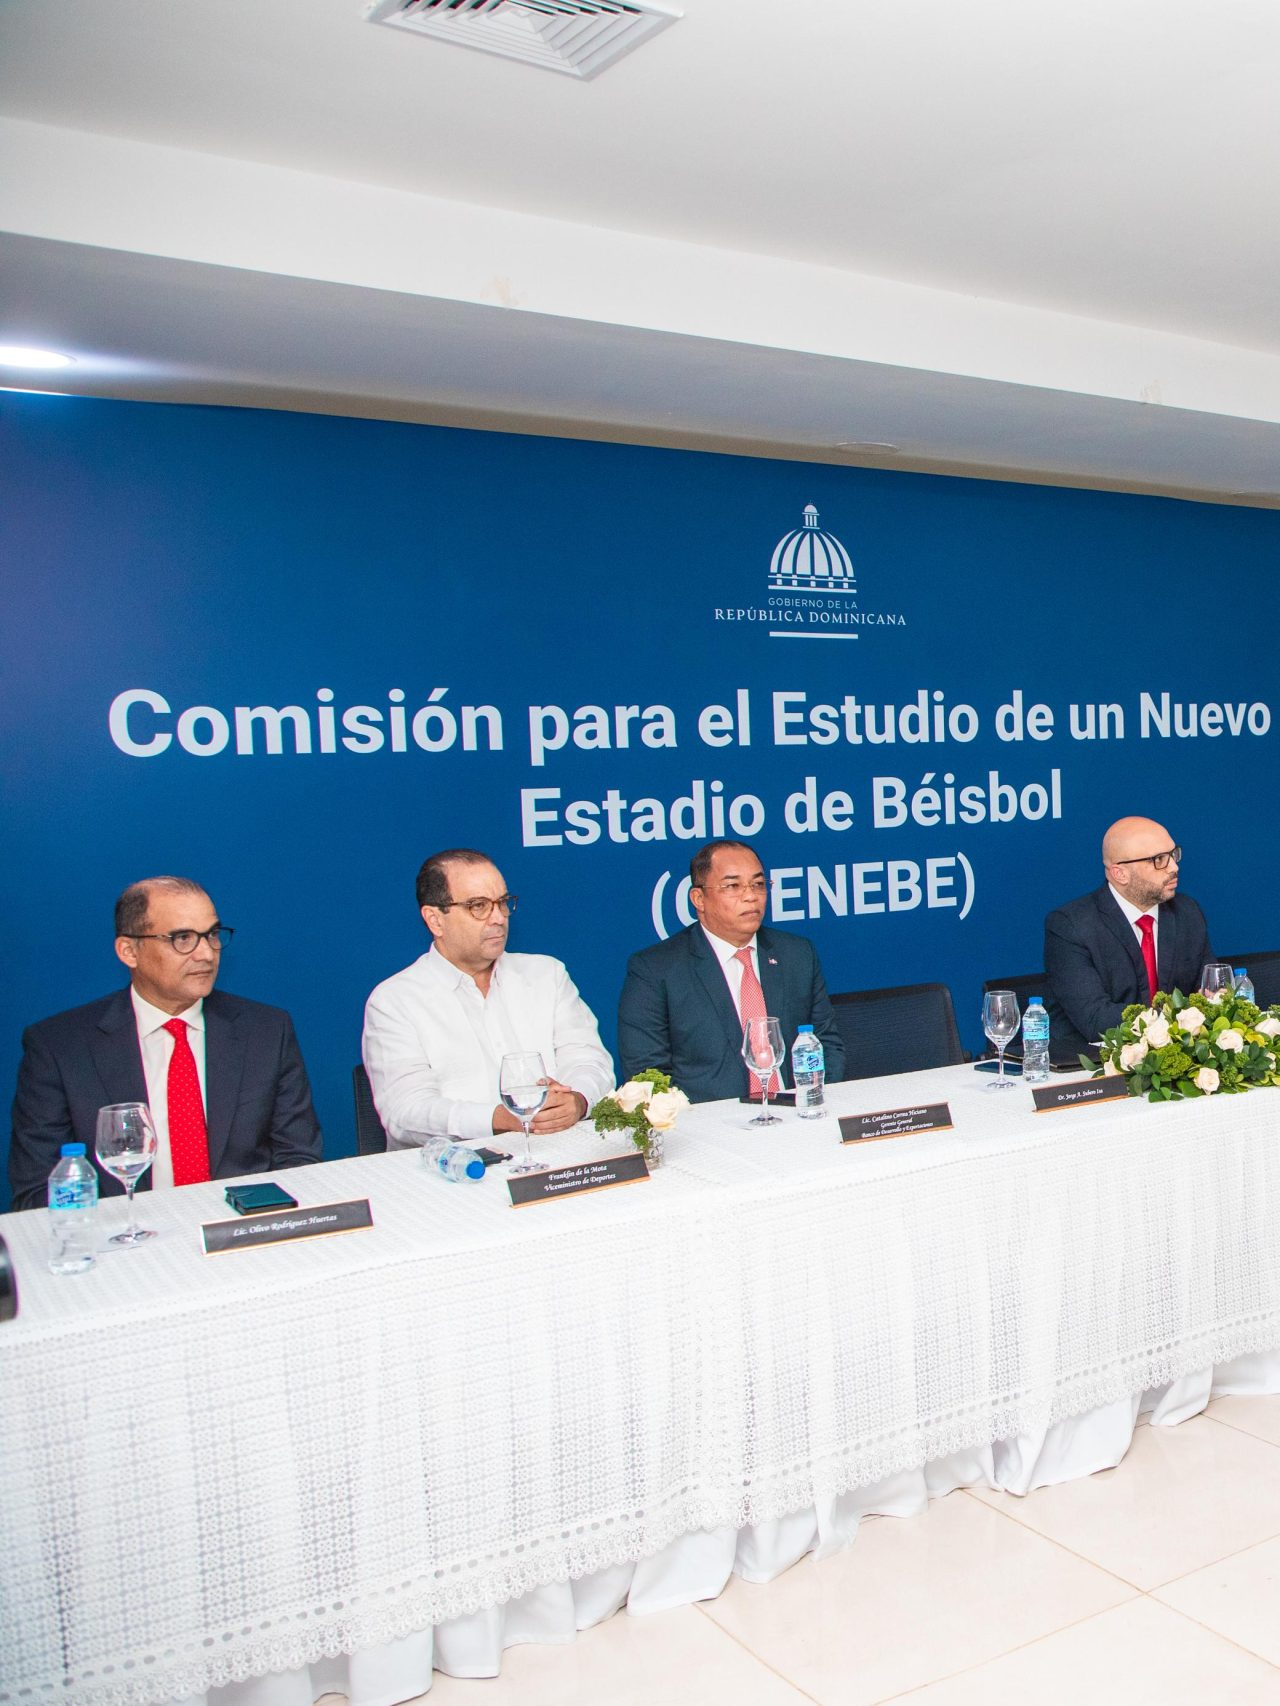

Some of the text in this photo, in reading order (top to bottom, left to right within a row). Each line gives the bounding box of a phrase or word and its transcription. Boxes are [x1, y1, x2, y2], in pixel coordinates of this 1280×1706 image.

[768, 597, 858, 610] GOBIERNO DE LA
[714, 606, 907, 626] REPÚBLICA DOMINICANA
[108, 687, 1272, 767] Comisión para el Estudio de un Nuevo
[520, 768, 1063, 848] Estadio de Béisbol
[861, 1116, 871, 1124] Lic.
[897, 1118, 913, 1127] General
[544, 1180, 581, 1191] Viceministro
[590, 1173, 616, 1184] Deportes
[548, 1165, 608, 1181] Franklin de la Mota
[233, 1227, 249, 1237] Lic.
[249, 1225, 270, 1234] Olivo
[308, 1214, 338, 1225] Huertas
